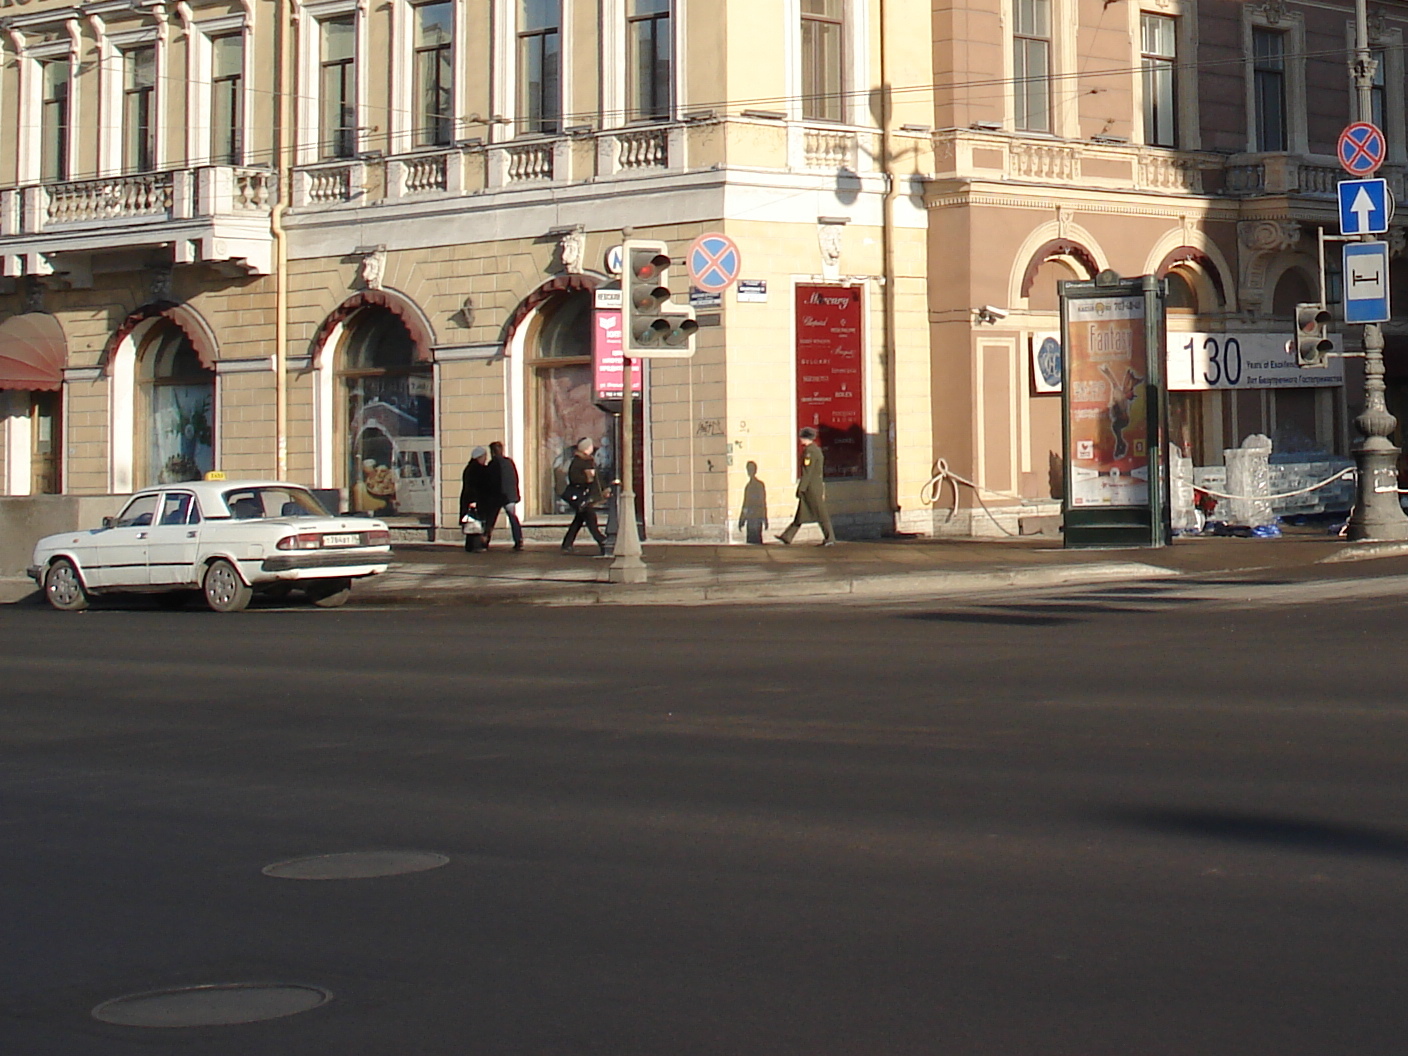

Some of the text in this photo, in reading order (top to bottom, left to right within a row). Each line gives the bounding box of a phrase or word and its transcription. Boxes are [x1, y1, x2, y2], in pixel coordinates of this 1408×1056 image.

[803, 291, 850, 310] Mercury
[1089, 324, 1133, 360] Fantasy
[1183, 337, 1242, 386] 130
